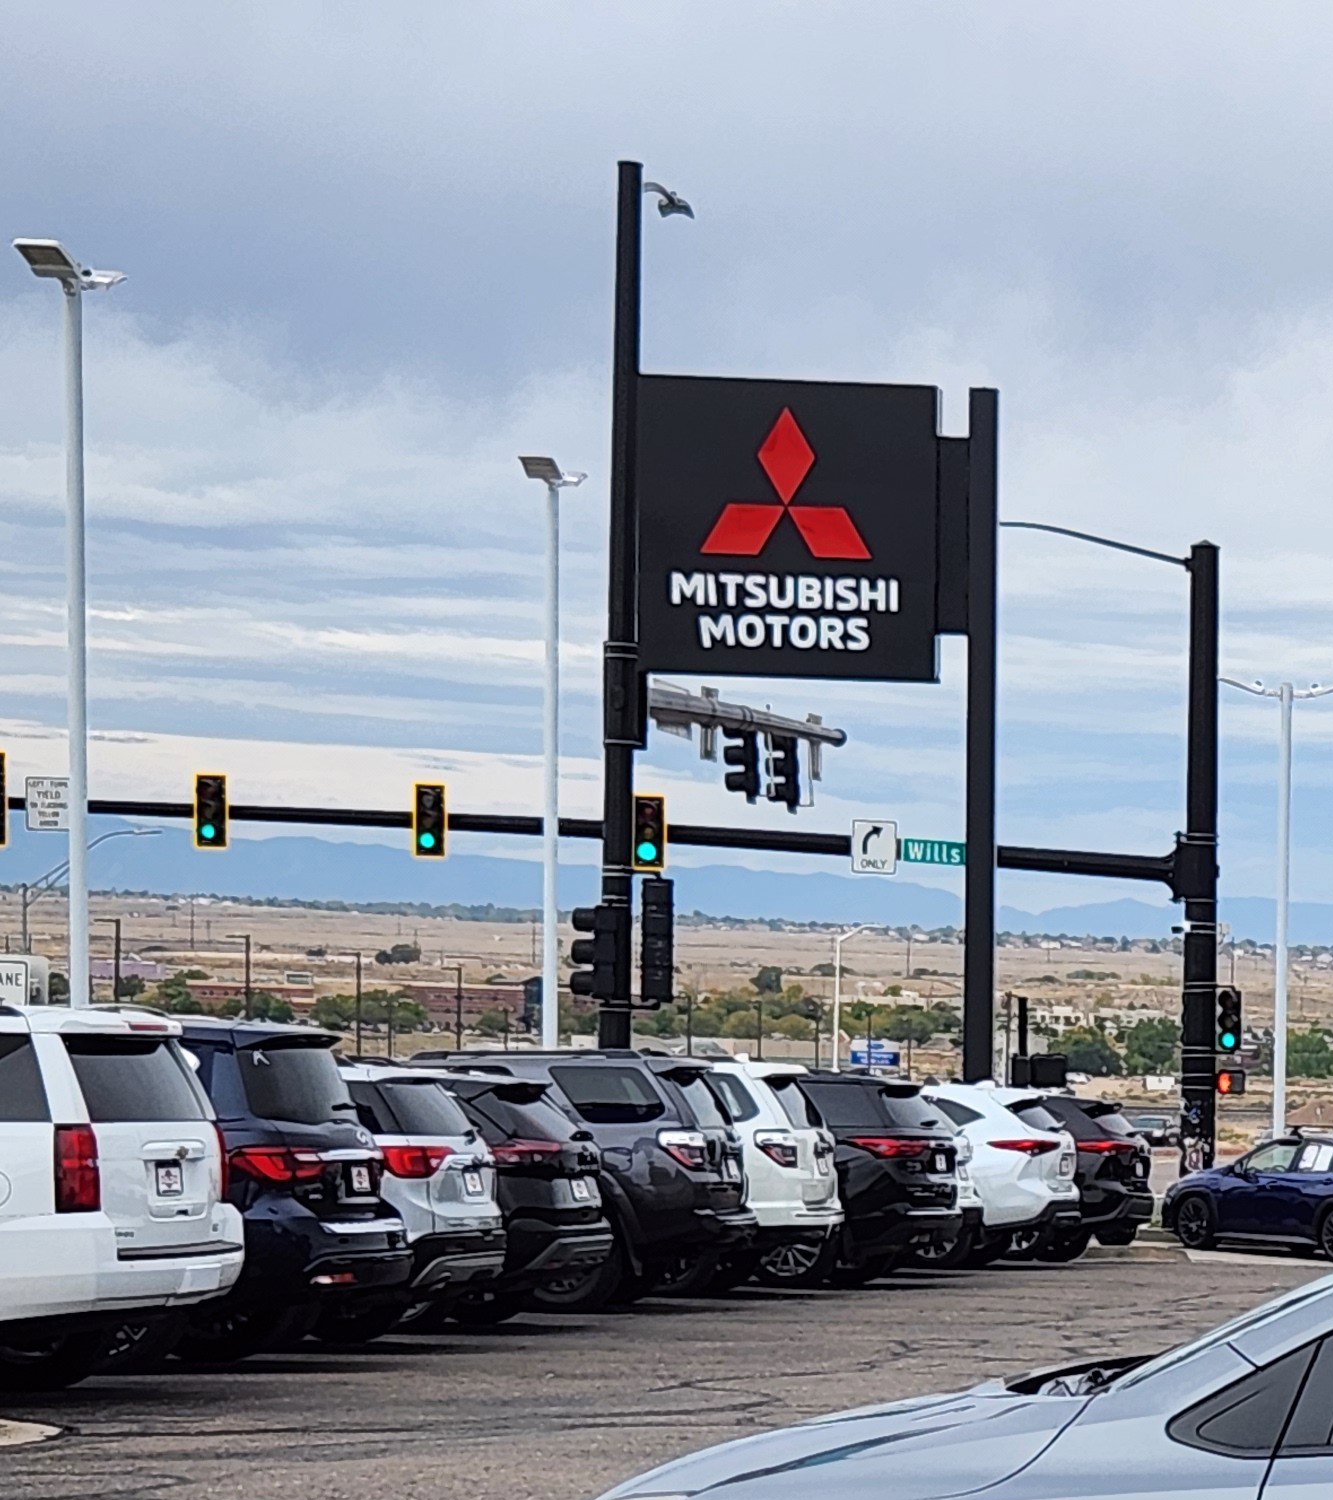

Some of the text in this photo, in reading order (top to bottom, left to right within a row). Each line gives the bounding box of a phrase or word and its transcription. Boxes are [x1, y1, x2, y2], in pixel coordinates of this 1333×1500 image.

[671, 571, 899, 613] MITSUBISHI
[699, 615, 870, 651] MOTORS
[860, 858, 887, 870] ONLY
[908, 841, 960, 863] Wills
